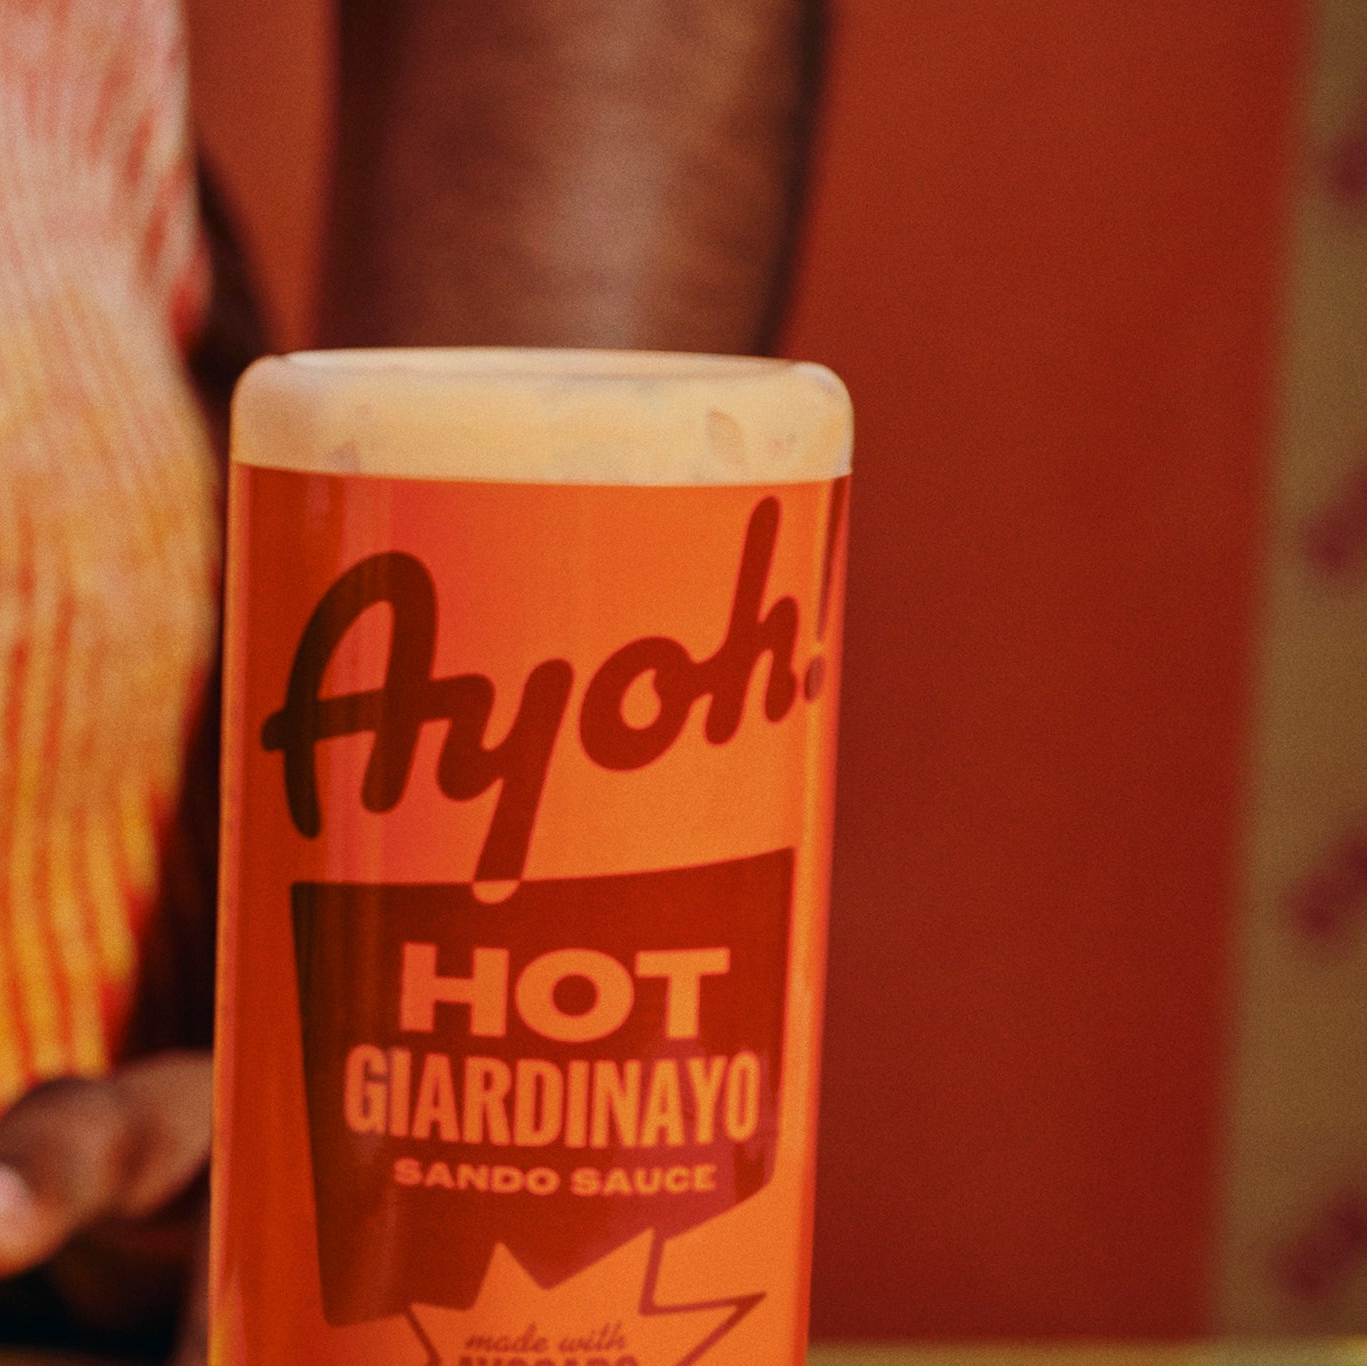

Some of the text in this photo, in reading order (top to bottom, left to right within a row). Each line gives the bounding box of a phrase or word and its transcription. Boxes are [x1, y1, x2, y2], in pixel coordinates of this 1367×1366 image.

[400, 941, 730, 1043] HOT
[344, 1043, 761, 1149] GIARDINAYO
[393, 1158, 717, 1197] SANDO SAUCE
[464, 1321, 626, 1354] made with
